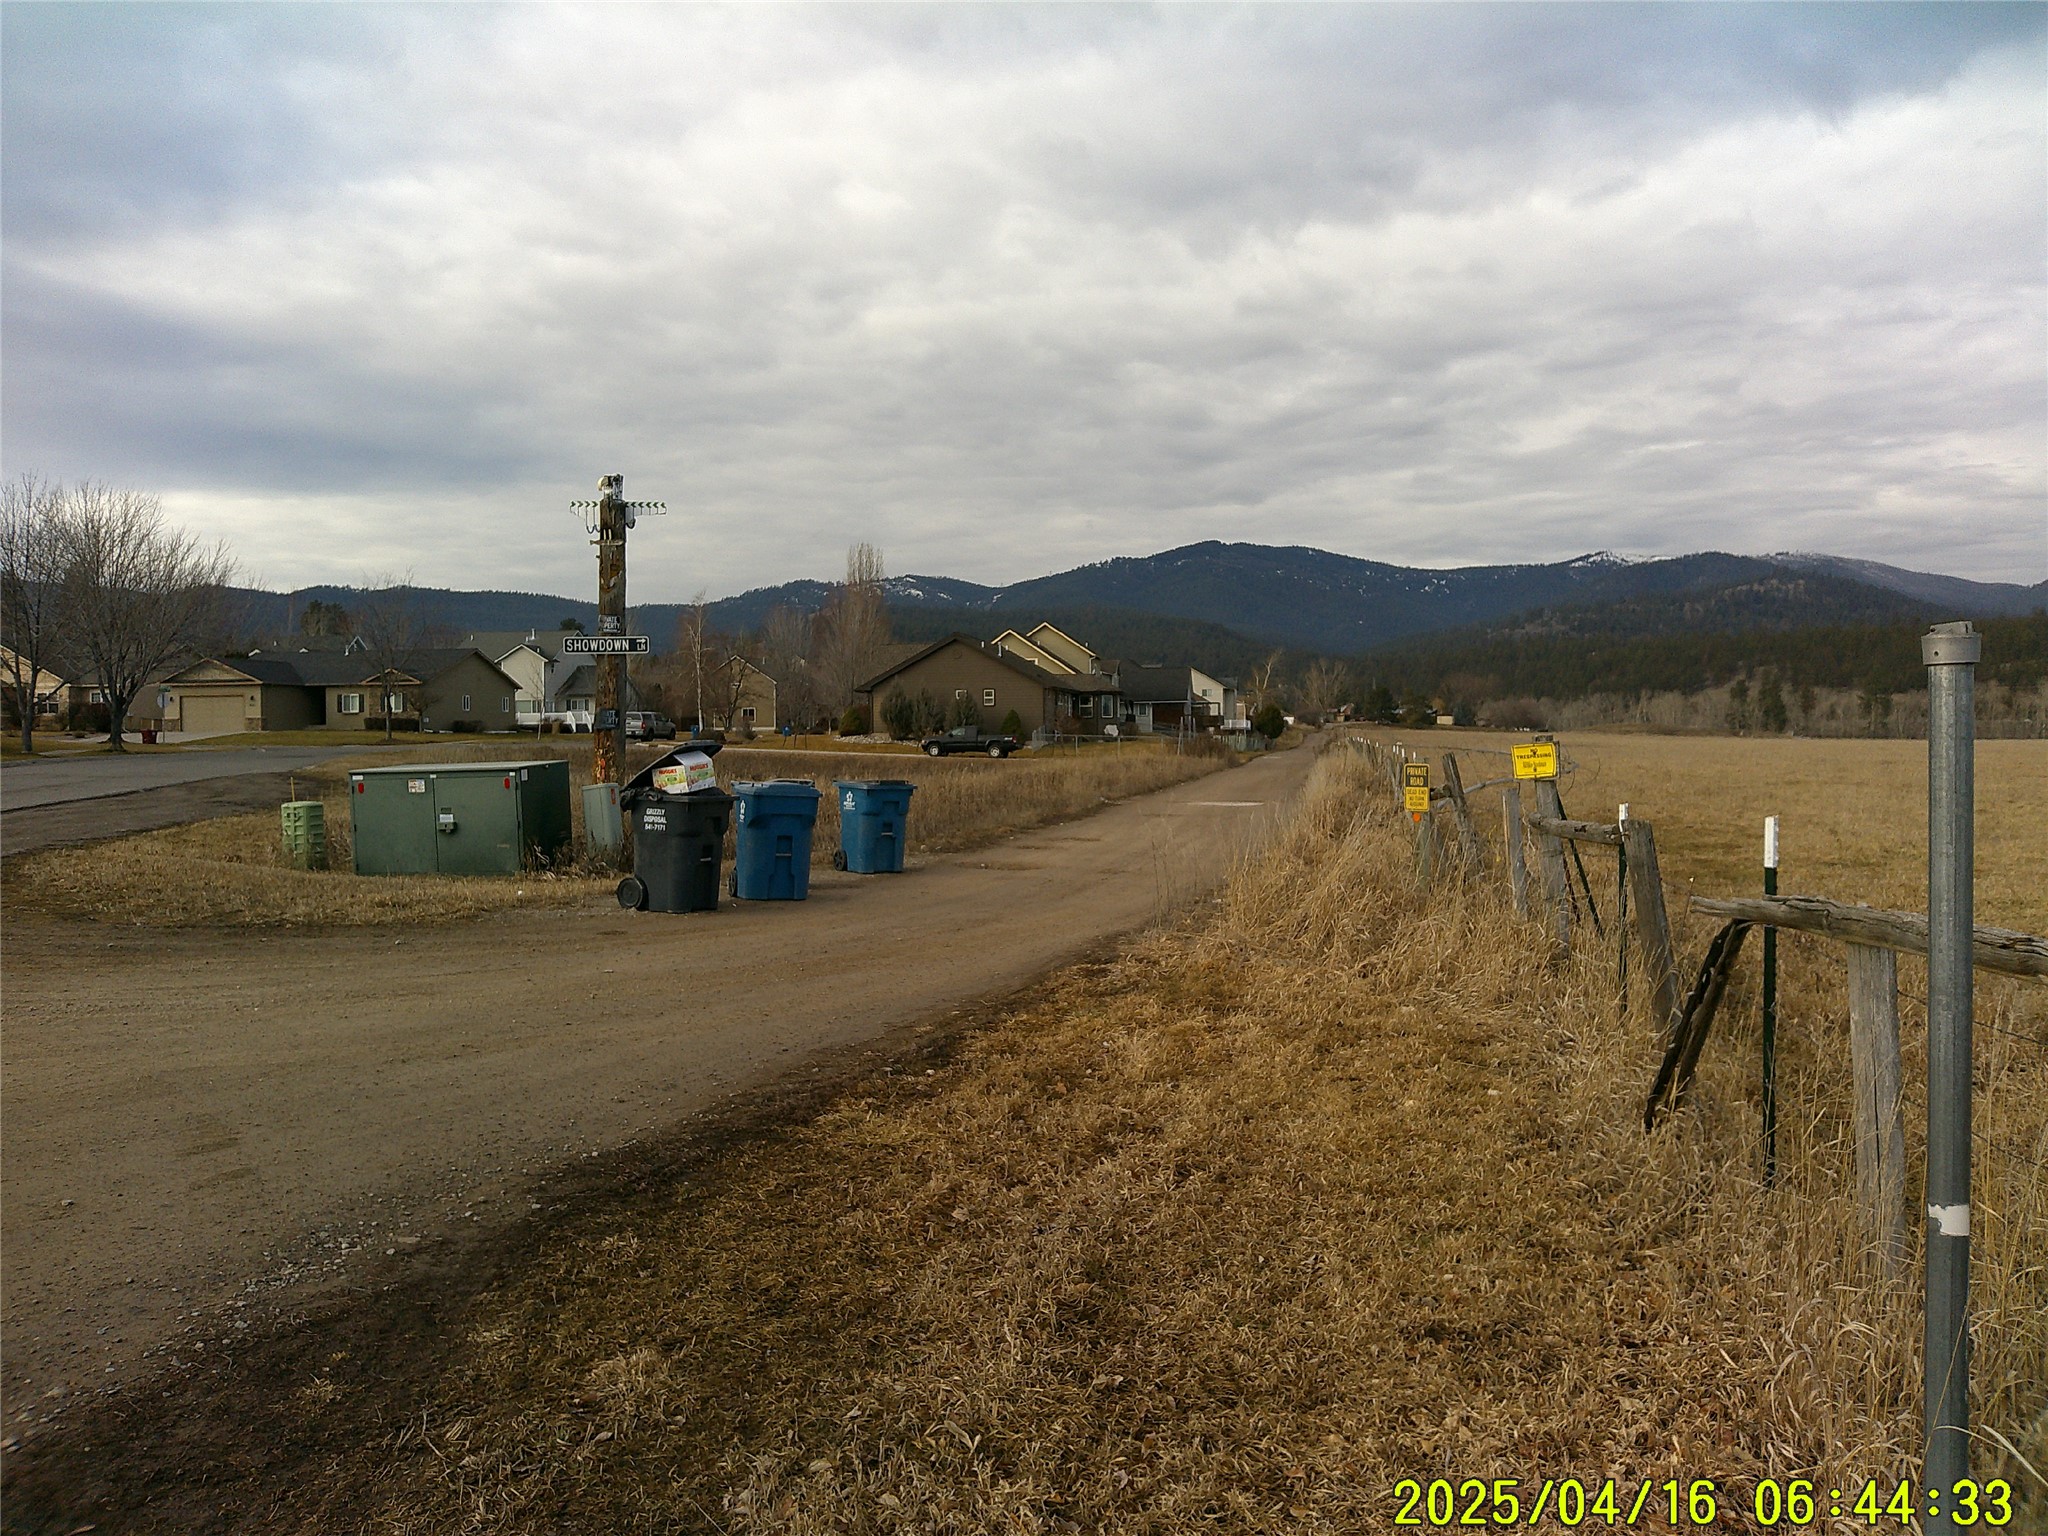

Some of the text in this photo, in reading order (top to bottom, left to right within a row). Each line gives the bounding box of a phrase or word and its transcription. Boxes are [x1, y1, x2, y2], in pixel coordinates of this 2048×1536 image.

[566, 639, 646, 651] SHOWDOWN LN
[1406, 767, 1427, 776] PRIVATE
[1410, 776, 1424, 786] ROAD
[643, 815, 667, 824] DISPOSAL
